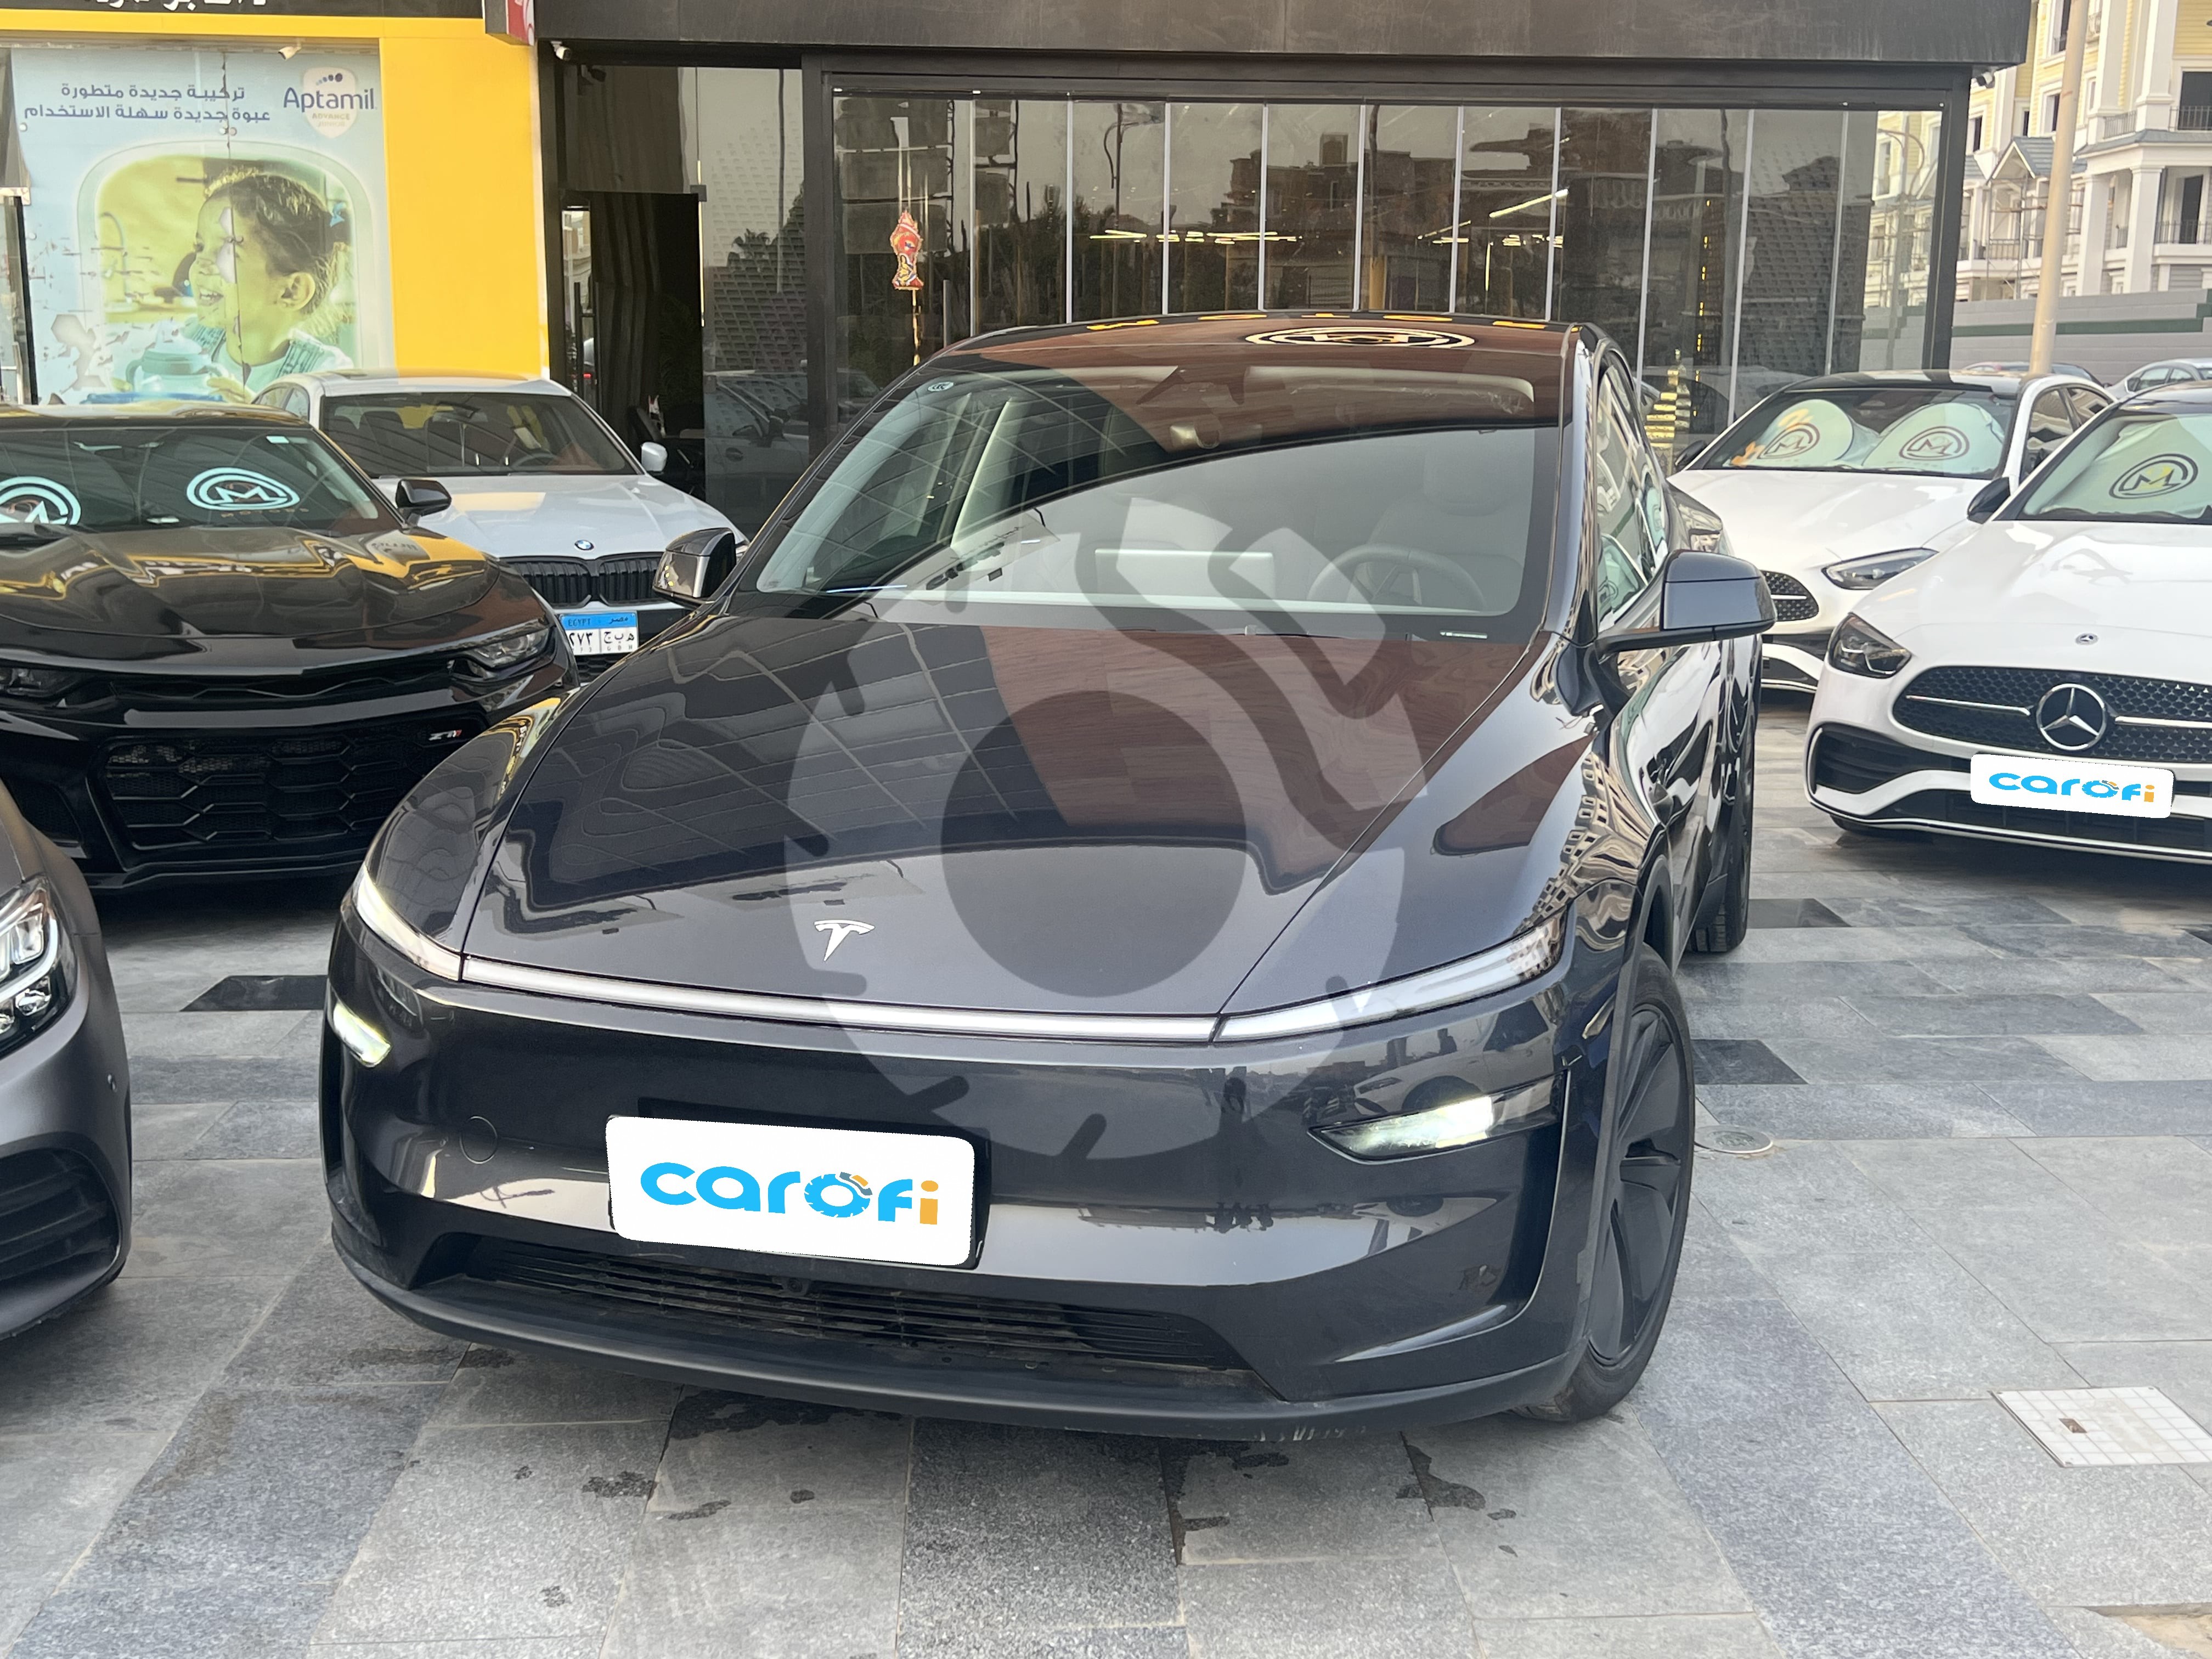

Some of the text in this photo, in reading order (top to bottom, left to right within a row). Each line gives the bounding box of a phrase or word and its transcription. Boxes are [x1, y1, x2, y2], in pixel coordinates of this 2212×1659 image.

[61, 83, 245, 102] تركيبة جديدة متطورة
[283, 87, 375, 113] Aptamil
[24, 104, 270, 123] عبوة جديدة سهلة الاستخدام
[312, 112, 351, 121] ADVANCE
